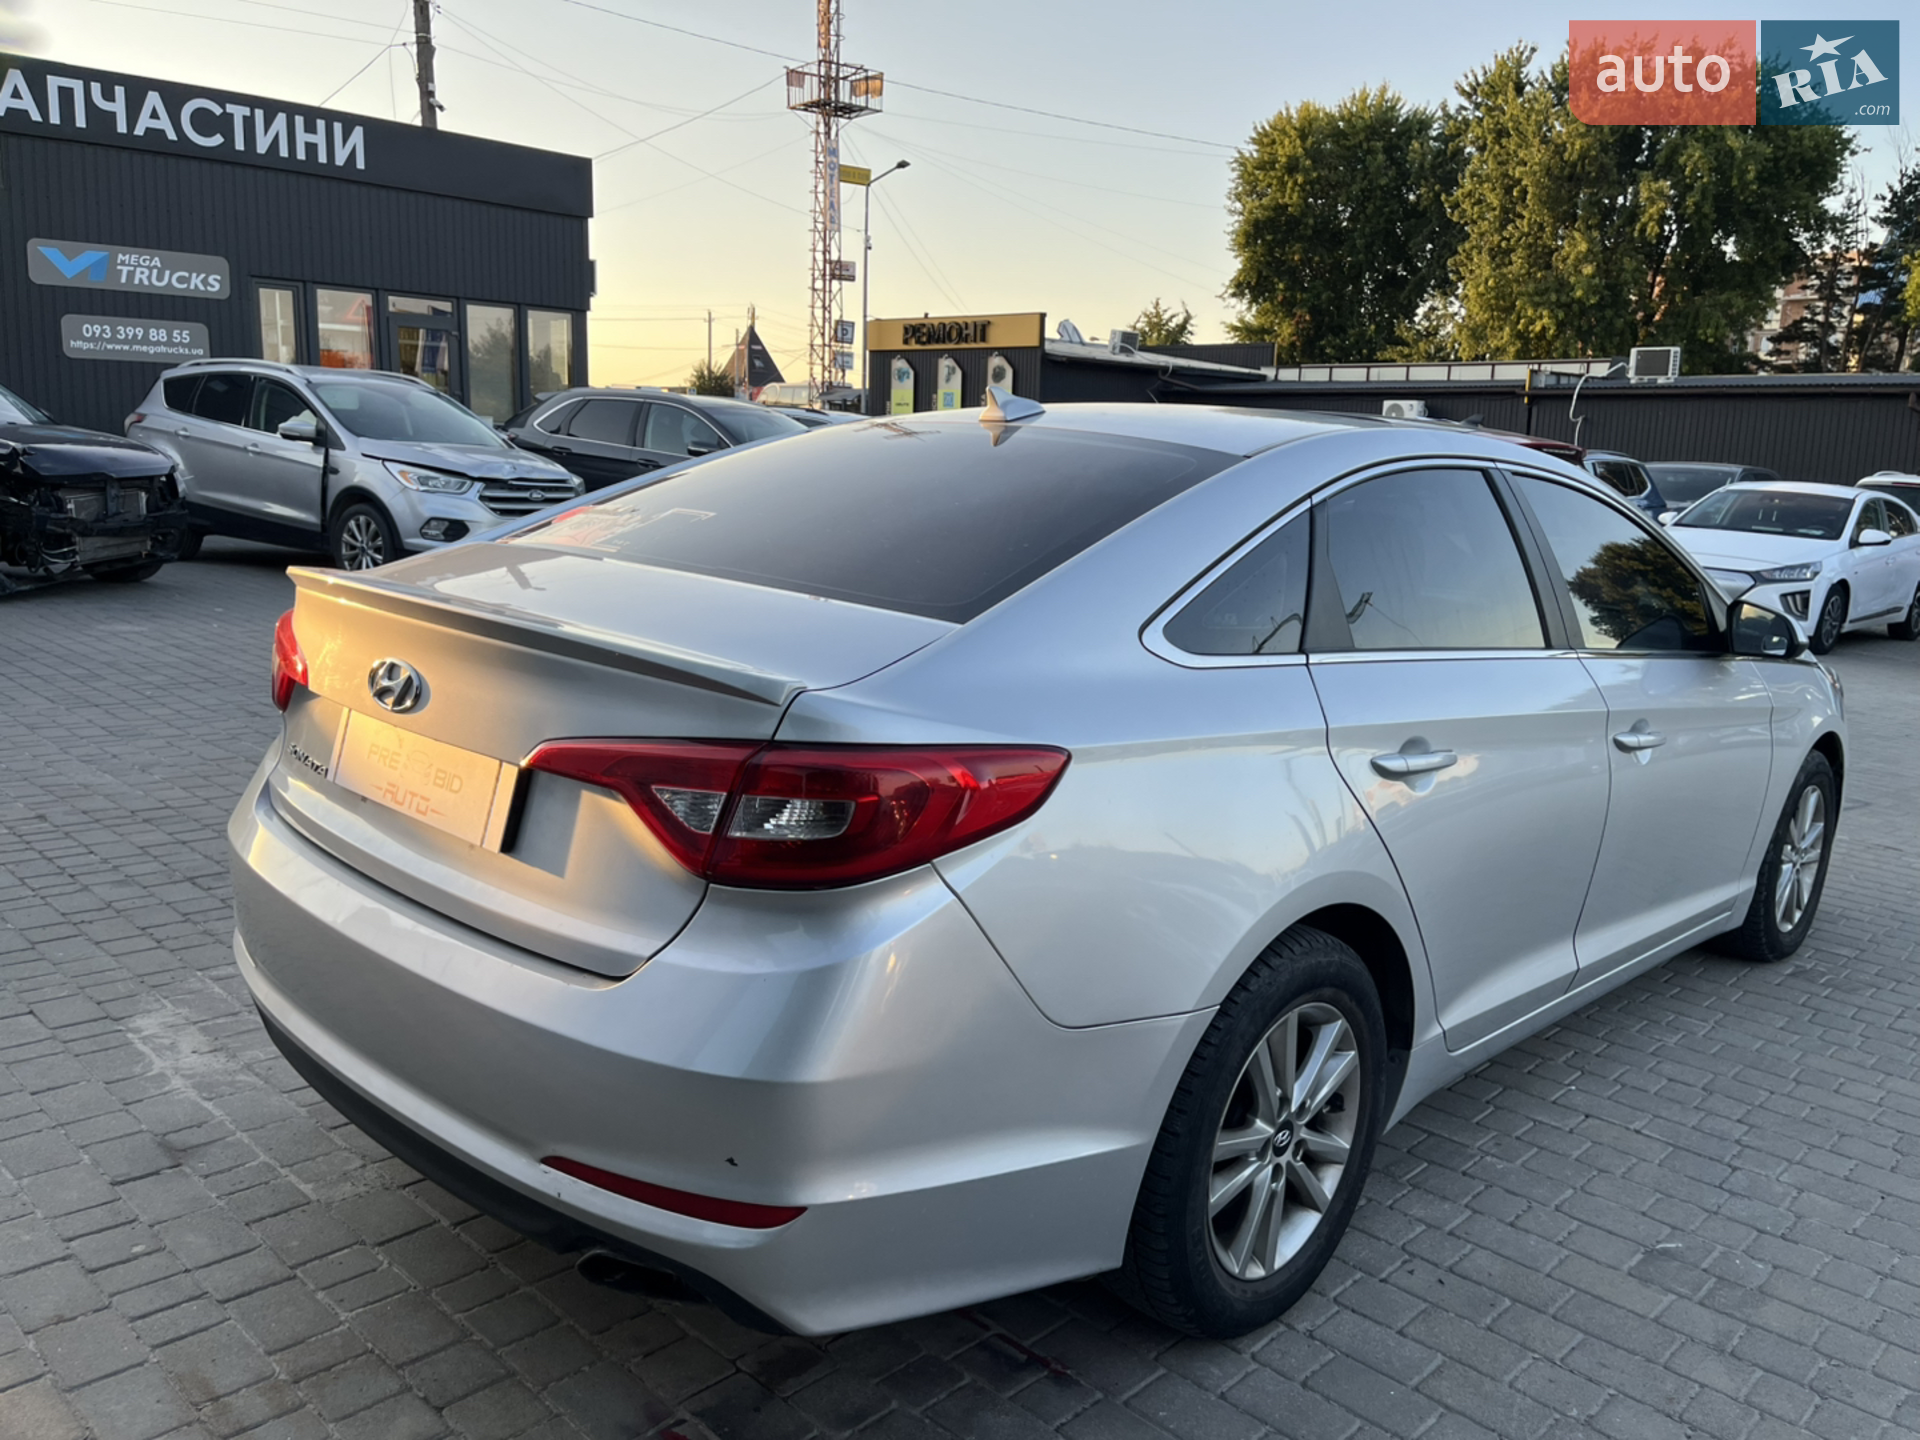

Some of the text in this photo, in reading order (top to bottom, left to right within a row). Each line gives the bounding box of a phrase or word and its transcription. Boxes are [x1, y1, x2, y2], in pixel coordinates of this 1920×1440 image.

[117, 253, 161, 267] MEGA
[116, 265, 221, 292] TRUCKS
[82, 324, 191, 343] 093 399 88 55
[903, 320, 991, 346] РЕМОНТ
[70, 340, 204, 355] https://www.megatrucks.ua
[367, 743, 464, 795] PRE BID
[382, 782, 431, 816] AUTO
